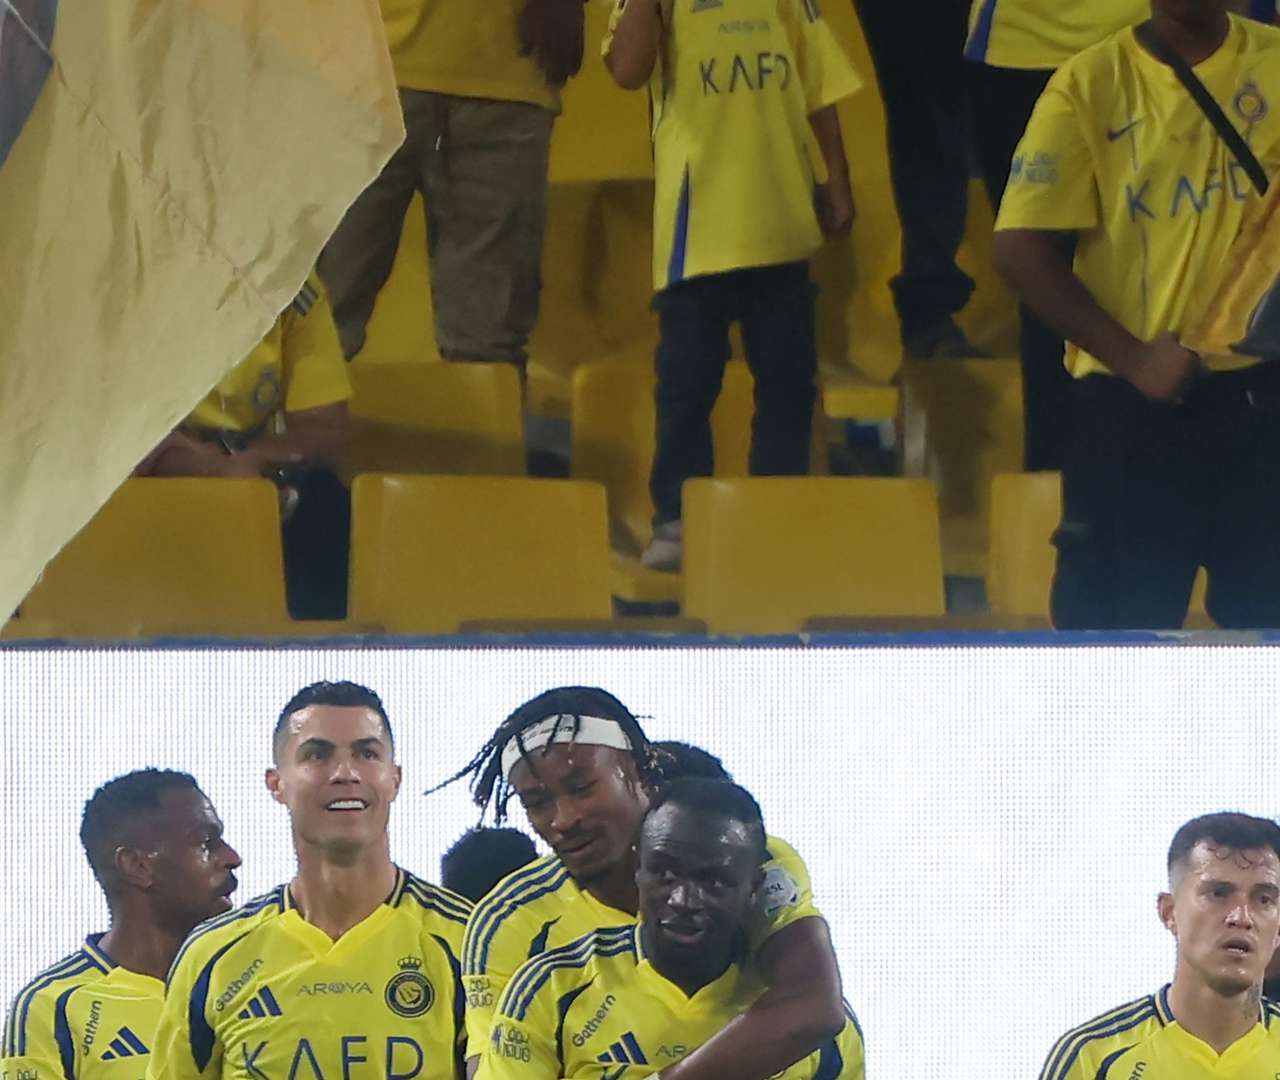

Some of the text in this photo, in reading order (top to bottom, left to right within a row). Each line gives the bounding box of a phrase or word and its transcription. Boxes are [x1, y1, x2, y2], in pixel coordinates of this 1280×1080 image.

[215, 958, 264, 1012] Gathern
[297, 981, 374, 997] AROYA
[572, 993, 616, 1047] Gathern
